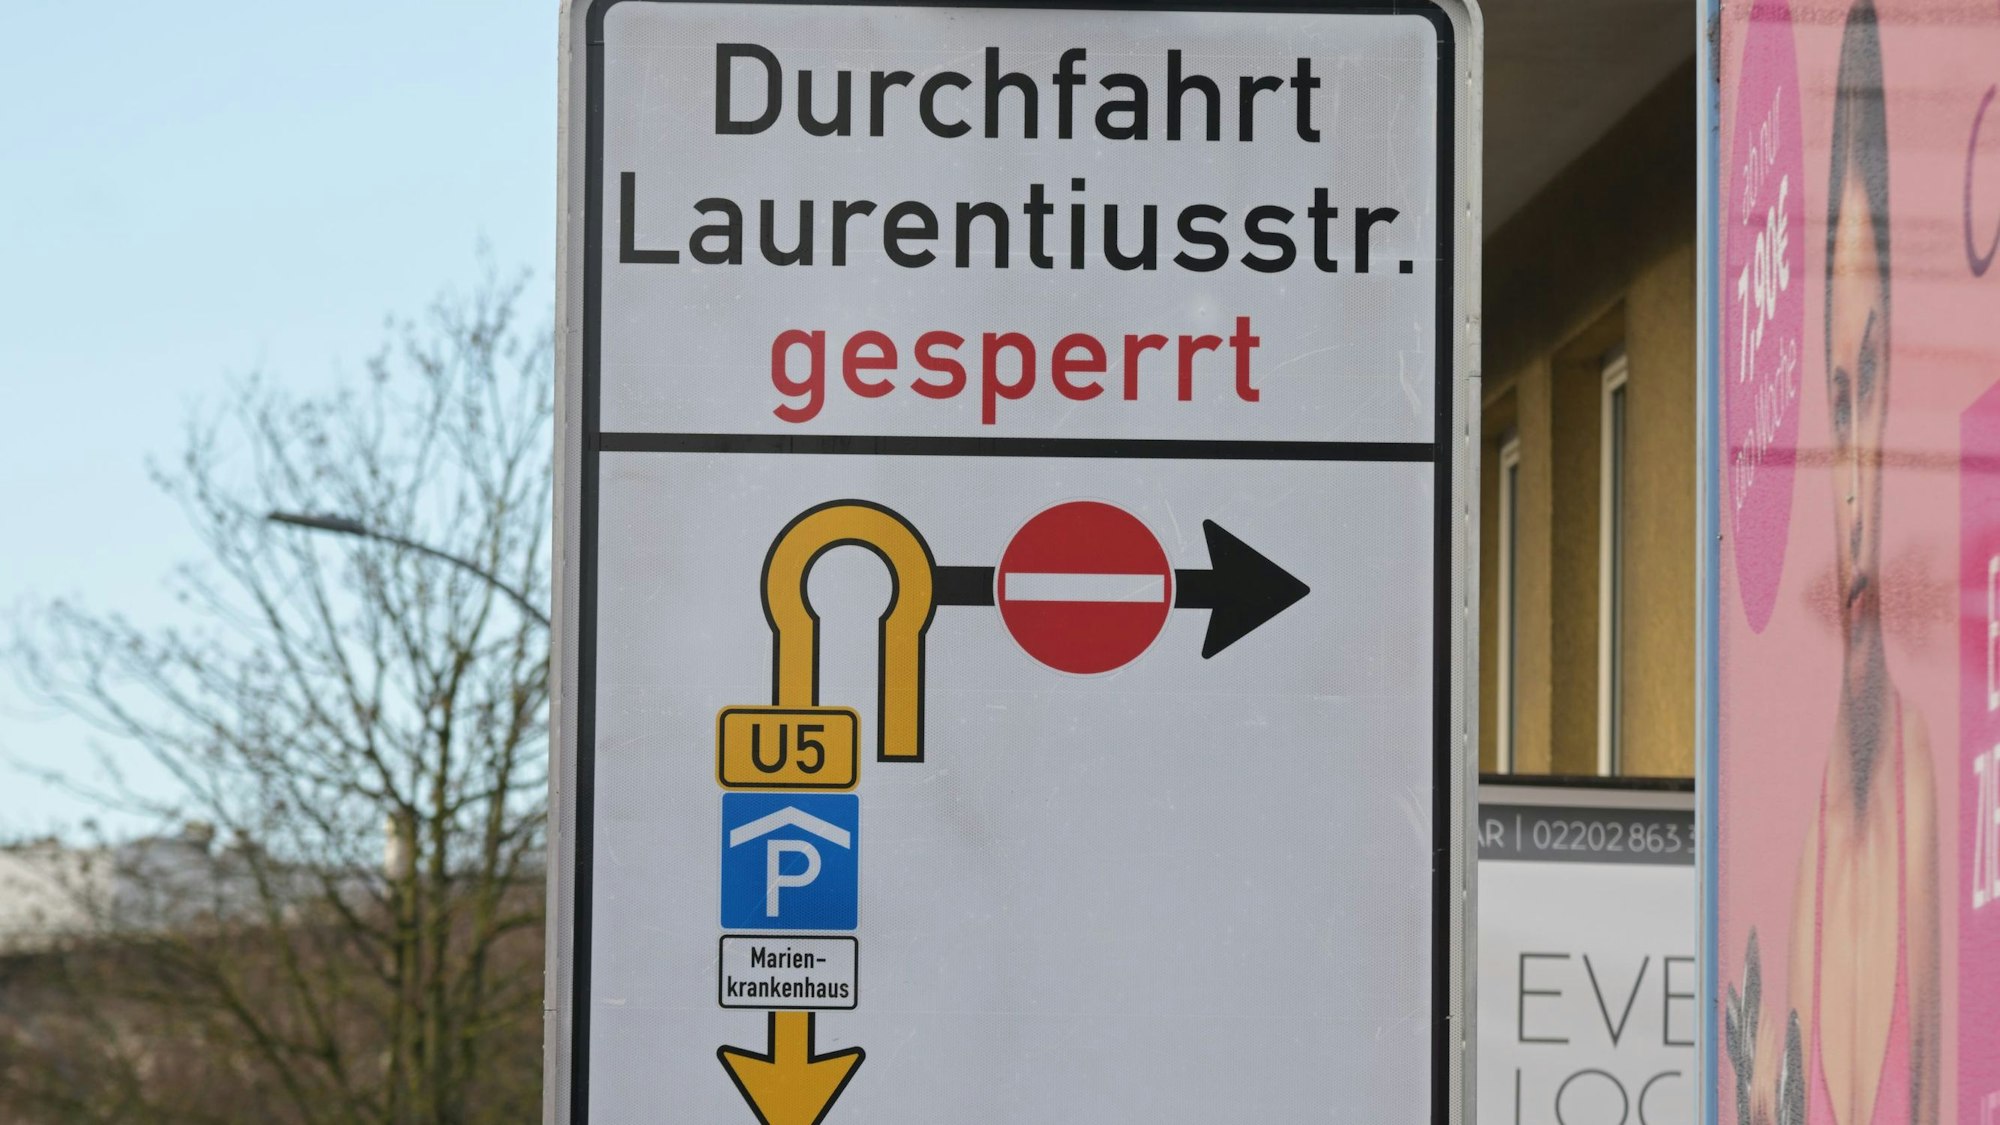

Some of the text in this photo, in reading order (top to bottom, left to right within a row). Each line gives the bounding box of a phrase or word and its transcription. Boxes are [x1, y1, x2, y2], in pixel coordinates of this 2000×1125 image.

[714, 42, 1322, 143] Durchfahrt
[1742, 85, 1782, 226] ab nur
[618, 171, 1414, 275] Laurentiusstr.
[1737, 173, 1790, 384] 7,90€
[771, 316, 1261, 425] gesperrt
[1754, 336, 1797, 464] Woche
[751, 723, 826, 775] U5
[766, 838, 822, 917] P
[1533, 820, 1622, 851] 02202
[727, 975, 850, 999] krankenhaus
[750, 946, 827, 969] Marien-
